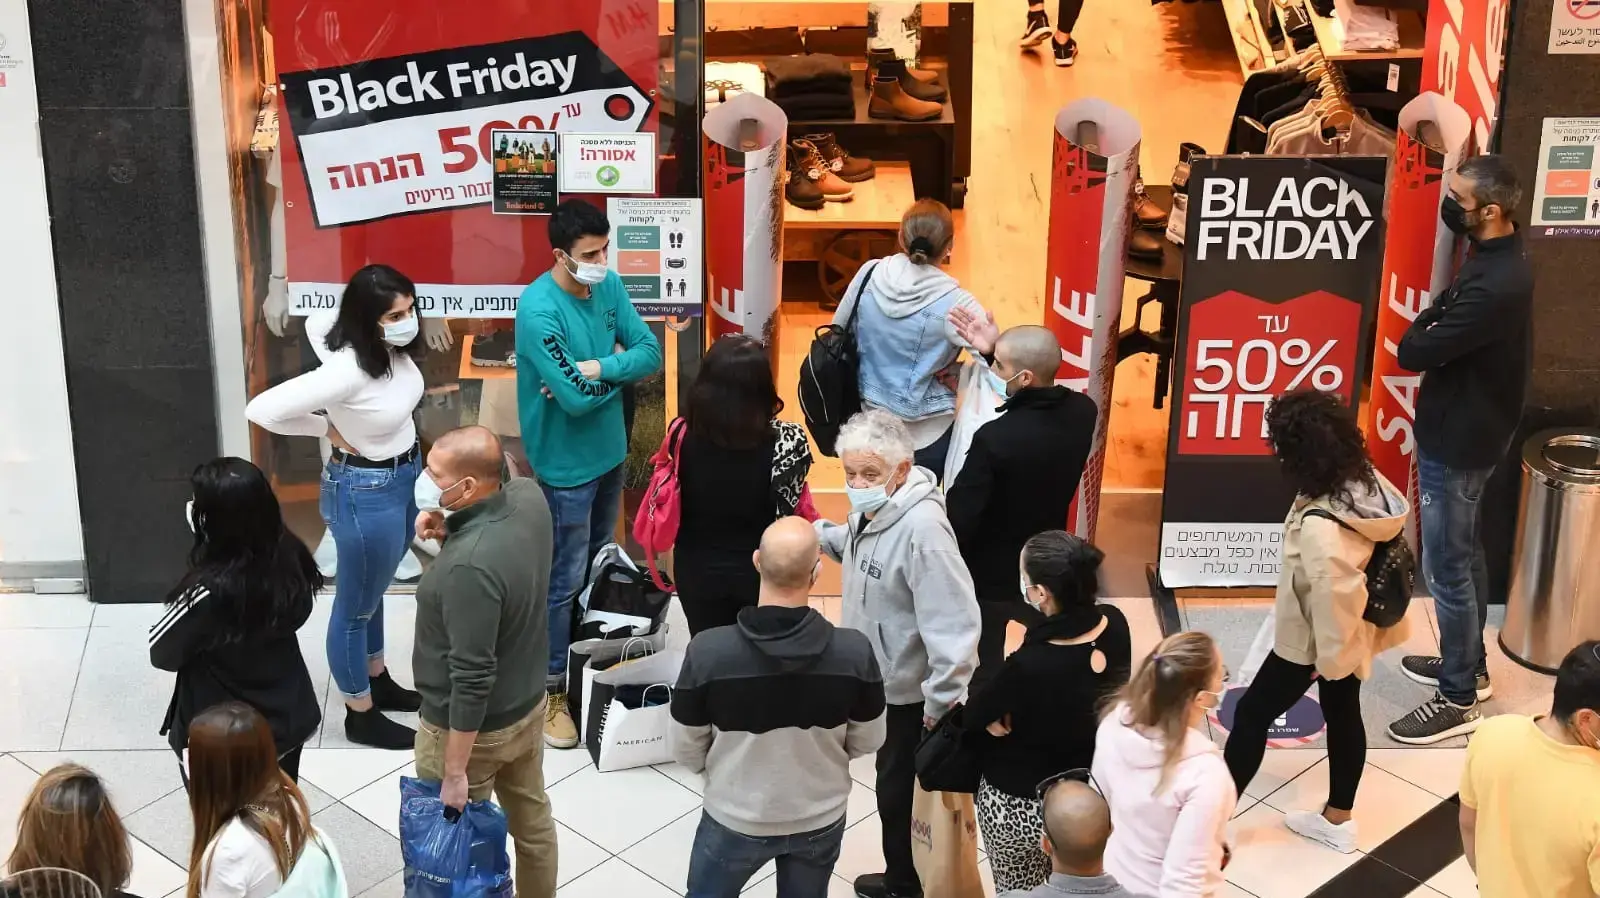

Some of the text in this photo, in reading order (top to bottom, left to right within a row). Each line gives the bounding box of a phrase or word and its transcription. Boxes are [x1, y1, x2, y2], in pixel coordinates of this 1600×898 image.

[307, 52, 577, 119] Black Friday
[562, 102, 581, 118] עד
[581, 147, 636, 161] אסורה!
[327, 152, 424, 190] הנחה
[405, 186, 455, 205] פריטים
[1201, 176, 1372, 218] BLACK
[629, 215, 655, 224] לקוחות
[1197, 220, 1375, 260] FRIDAY
[295, 291, 520, 314] תתפים, אין כפ ט.ל.ח.
[1053, 275, 1096, 396] LE
[1257, 315, 1289, 333] עד
[543, 335, 575, 377] EAGLE
[1193, 338, 1343, 392] 50%
[1376, 271, 1431, 456] SAE
[1187, 393, 1274, 438] חה
[1177, 531, 1262, 543] המשתתפים
[1164, 545, 1278, 560] אין כפל מבצעים
[1244, 563, 1282, 573] טבות.
[616, 735, 663, 746] AMERICAN
